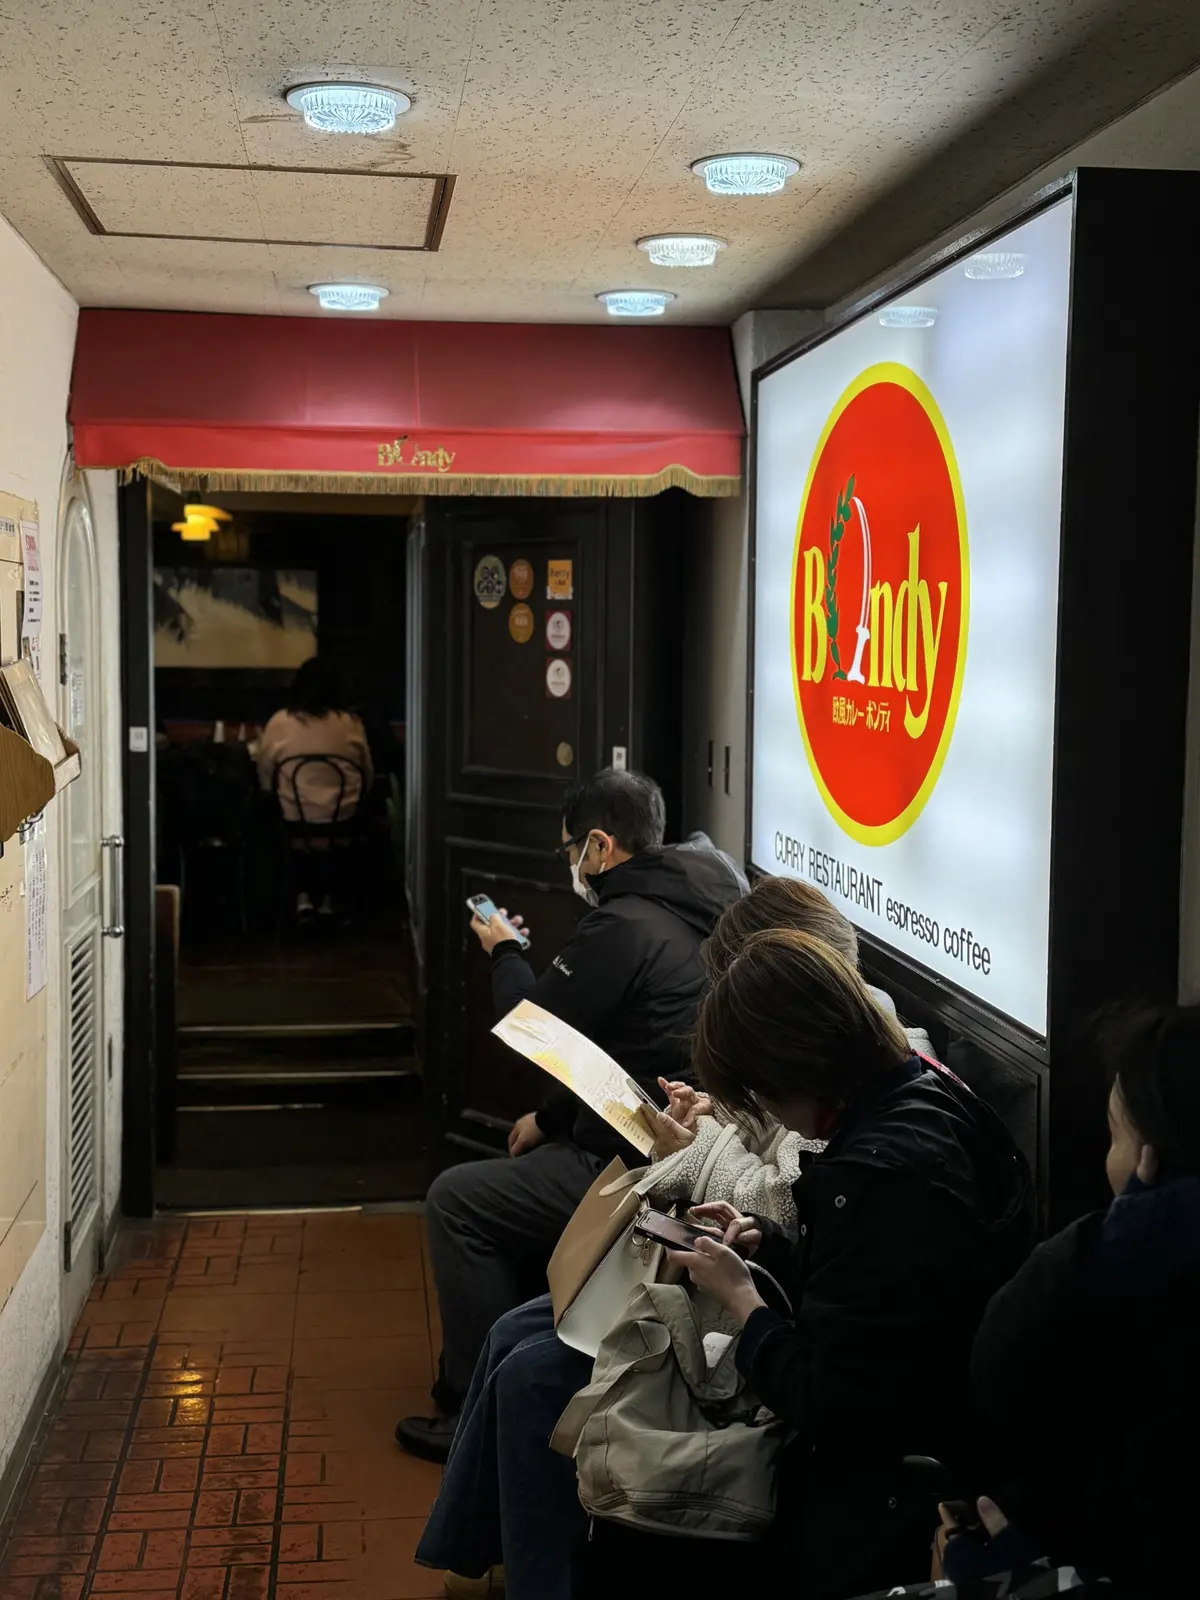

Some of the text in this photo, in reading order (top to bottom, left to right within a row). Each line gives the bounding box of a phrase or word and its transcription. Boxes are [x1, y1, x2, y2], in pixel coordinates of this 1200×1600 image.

[865, 699, 891, 733] ボンディ
[774, 831, 991, 975] CURRY RESTAURANT espresso coffee
